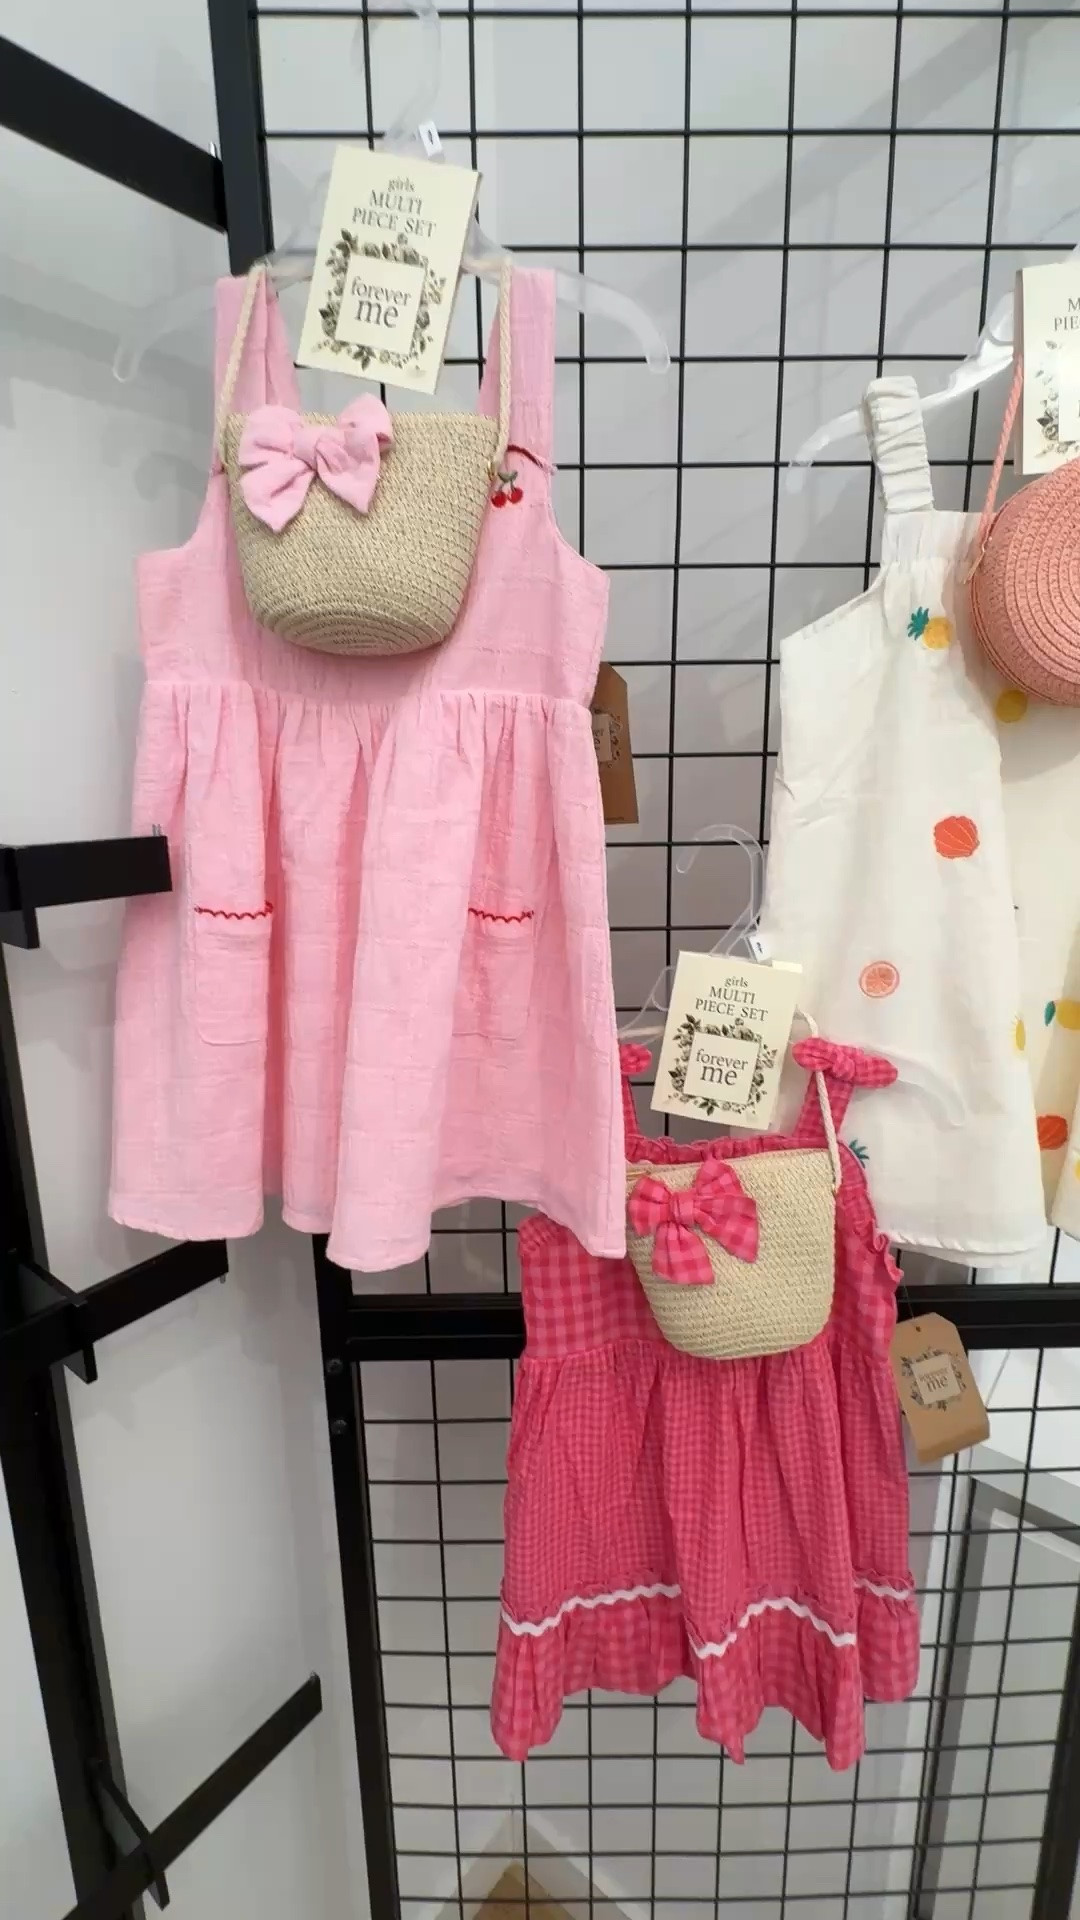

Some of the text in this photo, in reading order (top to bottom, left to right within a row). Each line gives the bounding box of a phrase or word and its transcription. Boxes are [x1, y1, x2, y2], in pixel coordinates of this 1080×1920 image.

[387, 176, 415, 192] girls
[369, 189, 422, 214] MULTI
[352, 207, 437, 237] PIECE SET
[351, 275, 412, 306] forever
[354, 300, 399, 328] me
[724, 976, 749, 988] girls
[709, 985, 756, 1005] MULTI
[695, 997, 769, 1022] PIECE SET
[695, 1048, 749, 1071] forever
[700, 1065, 738, 1087] me
[925, 1374, 950, 1393] me
